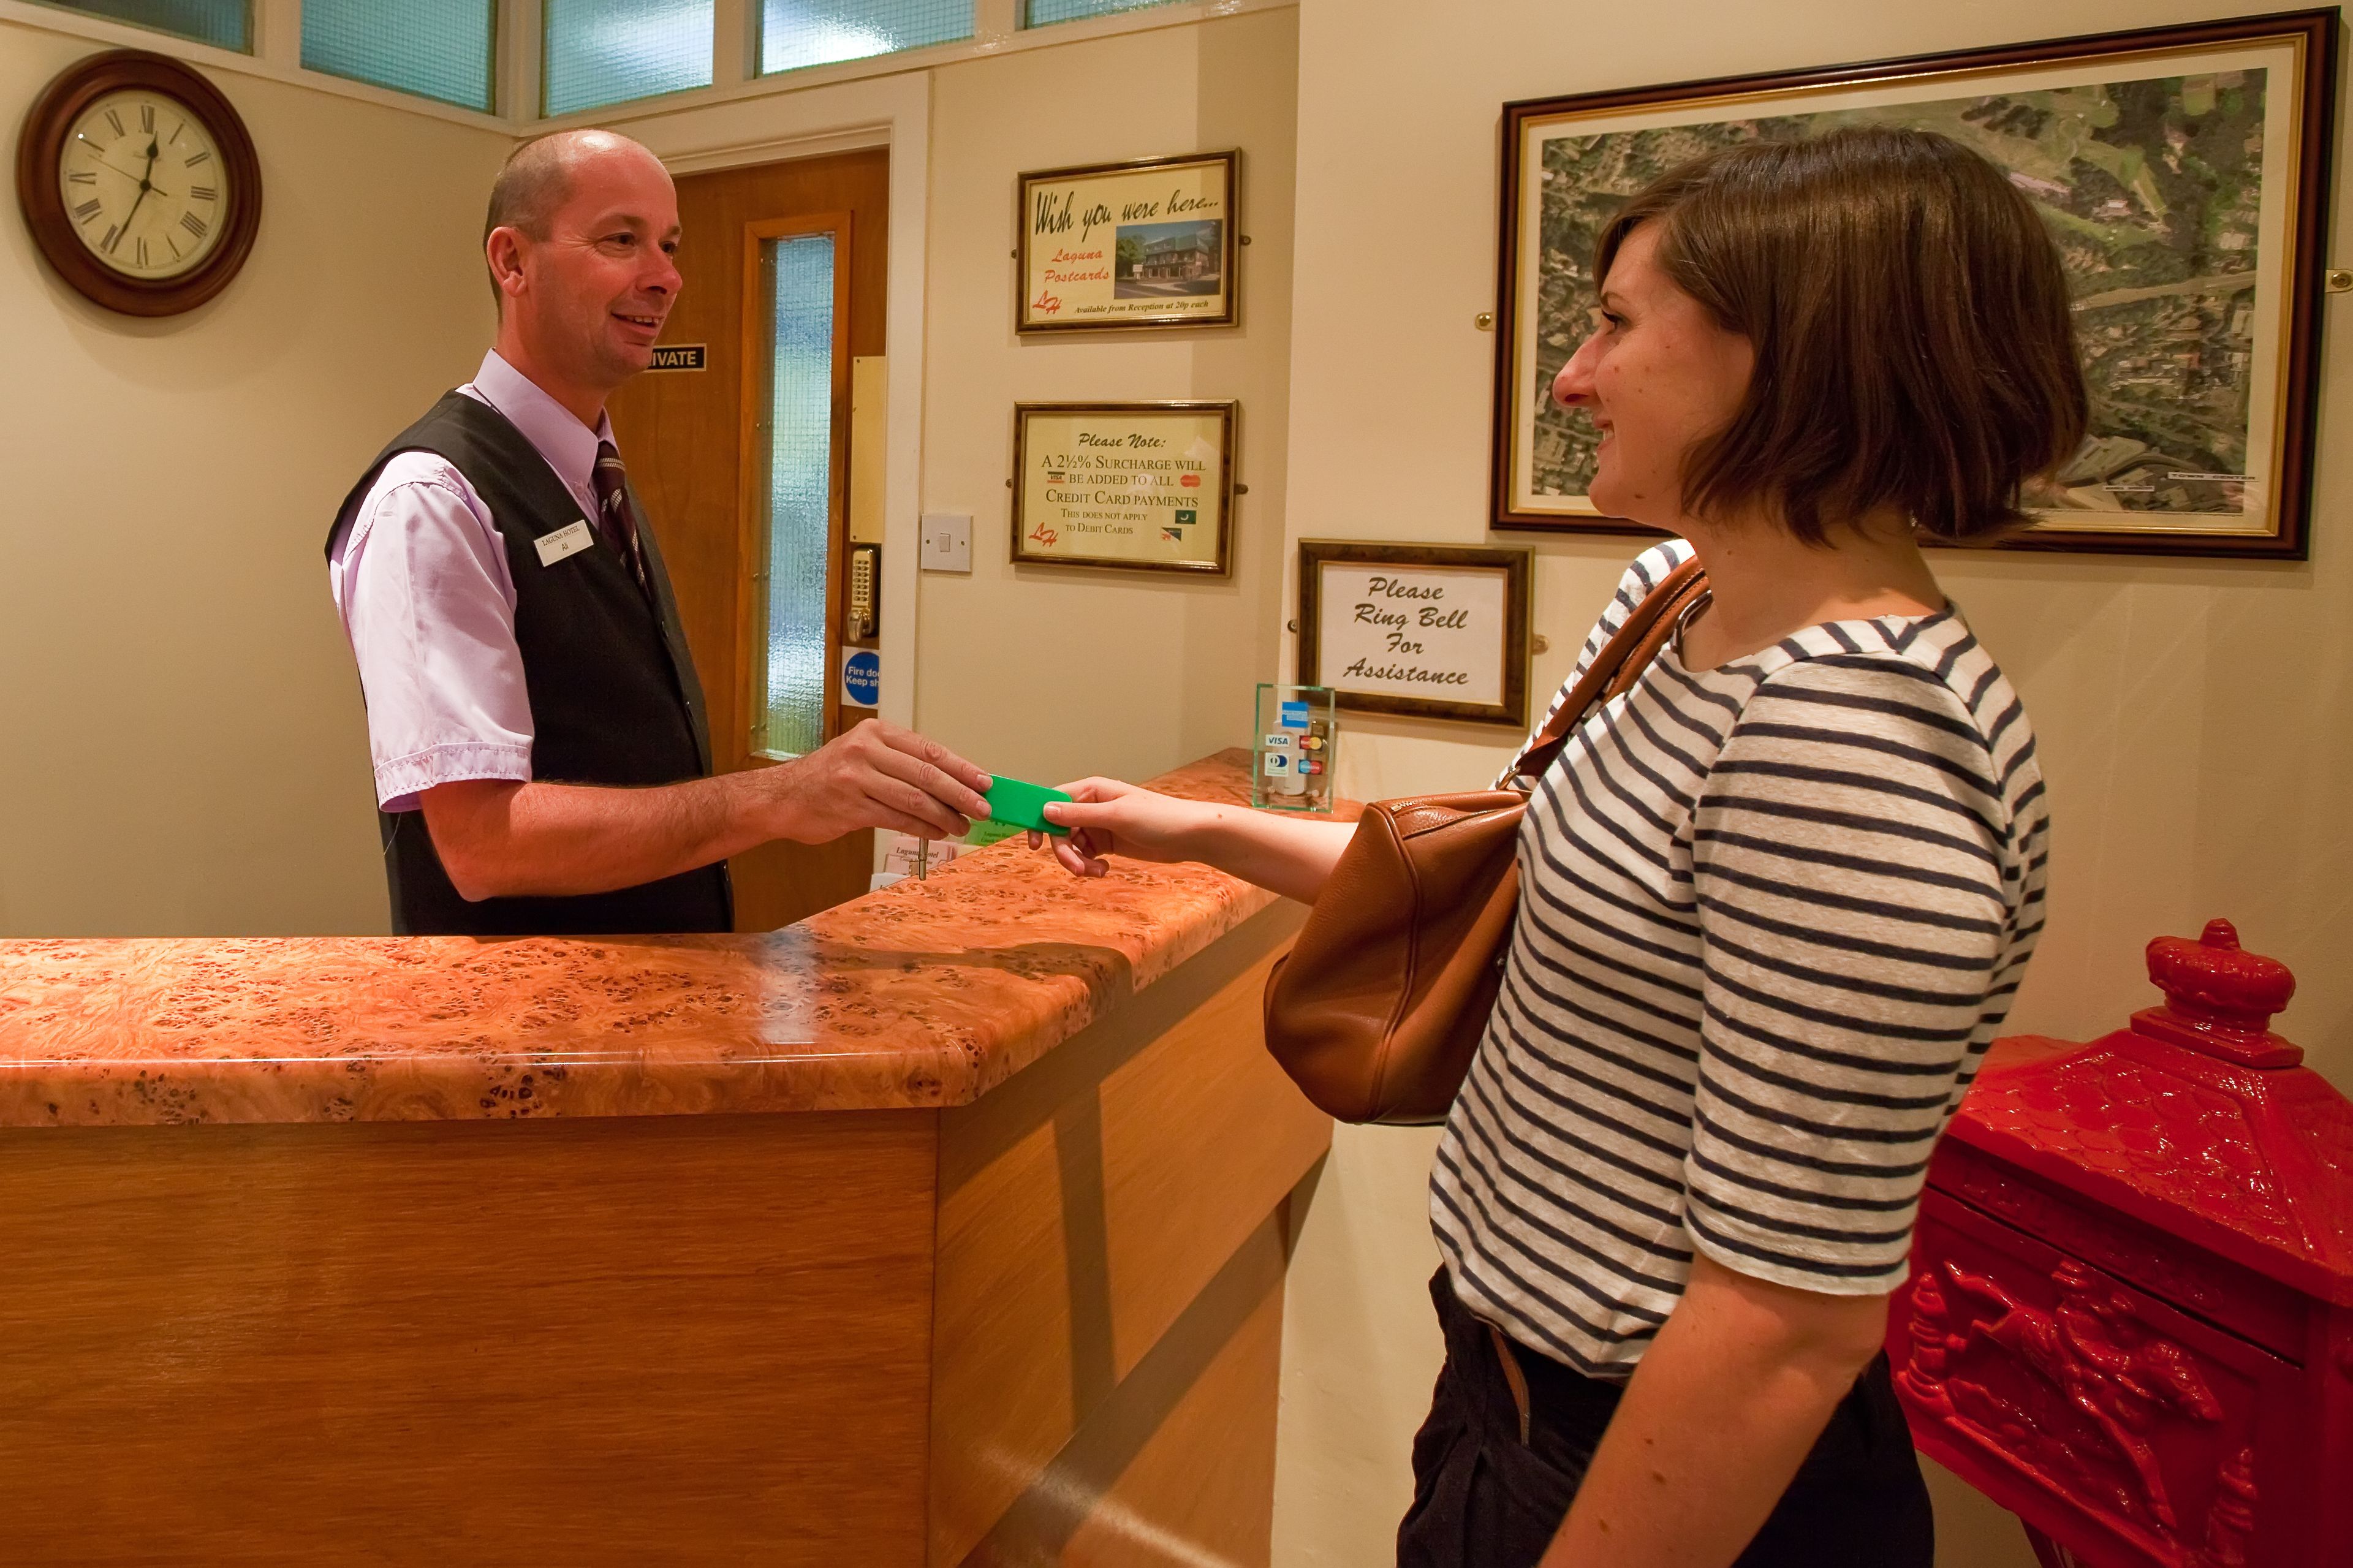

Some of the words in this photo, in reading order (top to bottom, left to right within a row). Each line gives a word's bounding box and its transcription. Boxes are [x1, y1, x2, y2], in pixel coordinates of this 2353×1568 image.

[1035, 191, 1074, 235] Wish
[1082, 203, 1112, 243] you
[1121, 202, 1159, 222] were
[1166, 189, 1218, 216] here...
[1051, 248, 1103, 264] Laguna
[1044, 267, 1110, 283] Postcards
[1075, 304, 1106, 314] Available
[1107, 304, 1126, 314] from
[1128, 302, 1164, 312] Reception
[1176, 301, 1189, 311] 20p
[1191, 300, 1209, 308] each
[653, 350, 697, 366] IVATE
[1078, 433, 1123, 447] Please
[1127, 433, 1167, 449] Note:
[1041, 455, 1052, 468] A
[1175, 460, 1207, 471] WILL
[1069, 474, 1083, 484] BE
[1086, 474, 1128, 485] ADDED
[1132, 476, 1148, 486] TO
[1151, 475, 1175, 487] ALL
[1134, 495, 1199, 507] PAYMENTS
[1065, 523, 1075, 532] TO
[542, 533, 563, 547] LAGUNA
[563, 526, 580, 537] HOTEL
[1368, 577, 1445, 600] Please
[1354, 603, 1409, 631] Ring
[1418, 607, 1469, 629] Bell
[1385, 632, 1425, 655] For
[849, 666, 864, 676] Fire
[866, 668, 880, 678] do
[1343, 657, 1469, 685] Assistance
[846, 675, 868, 687] Keep
[870, 678, 879, 687] sh
[1268, 737, 1289, 745] VISA
